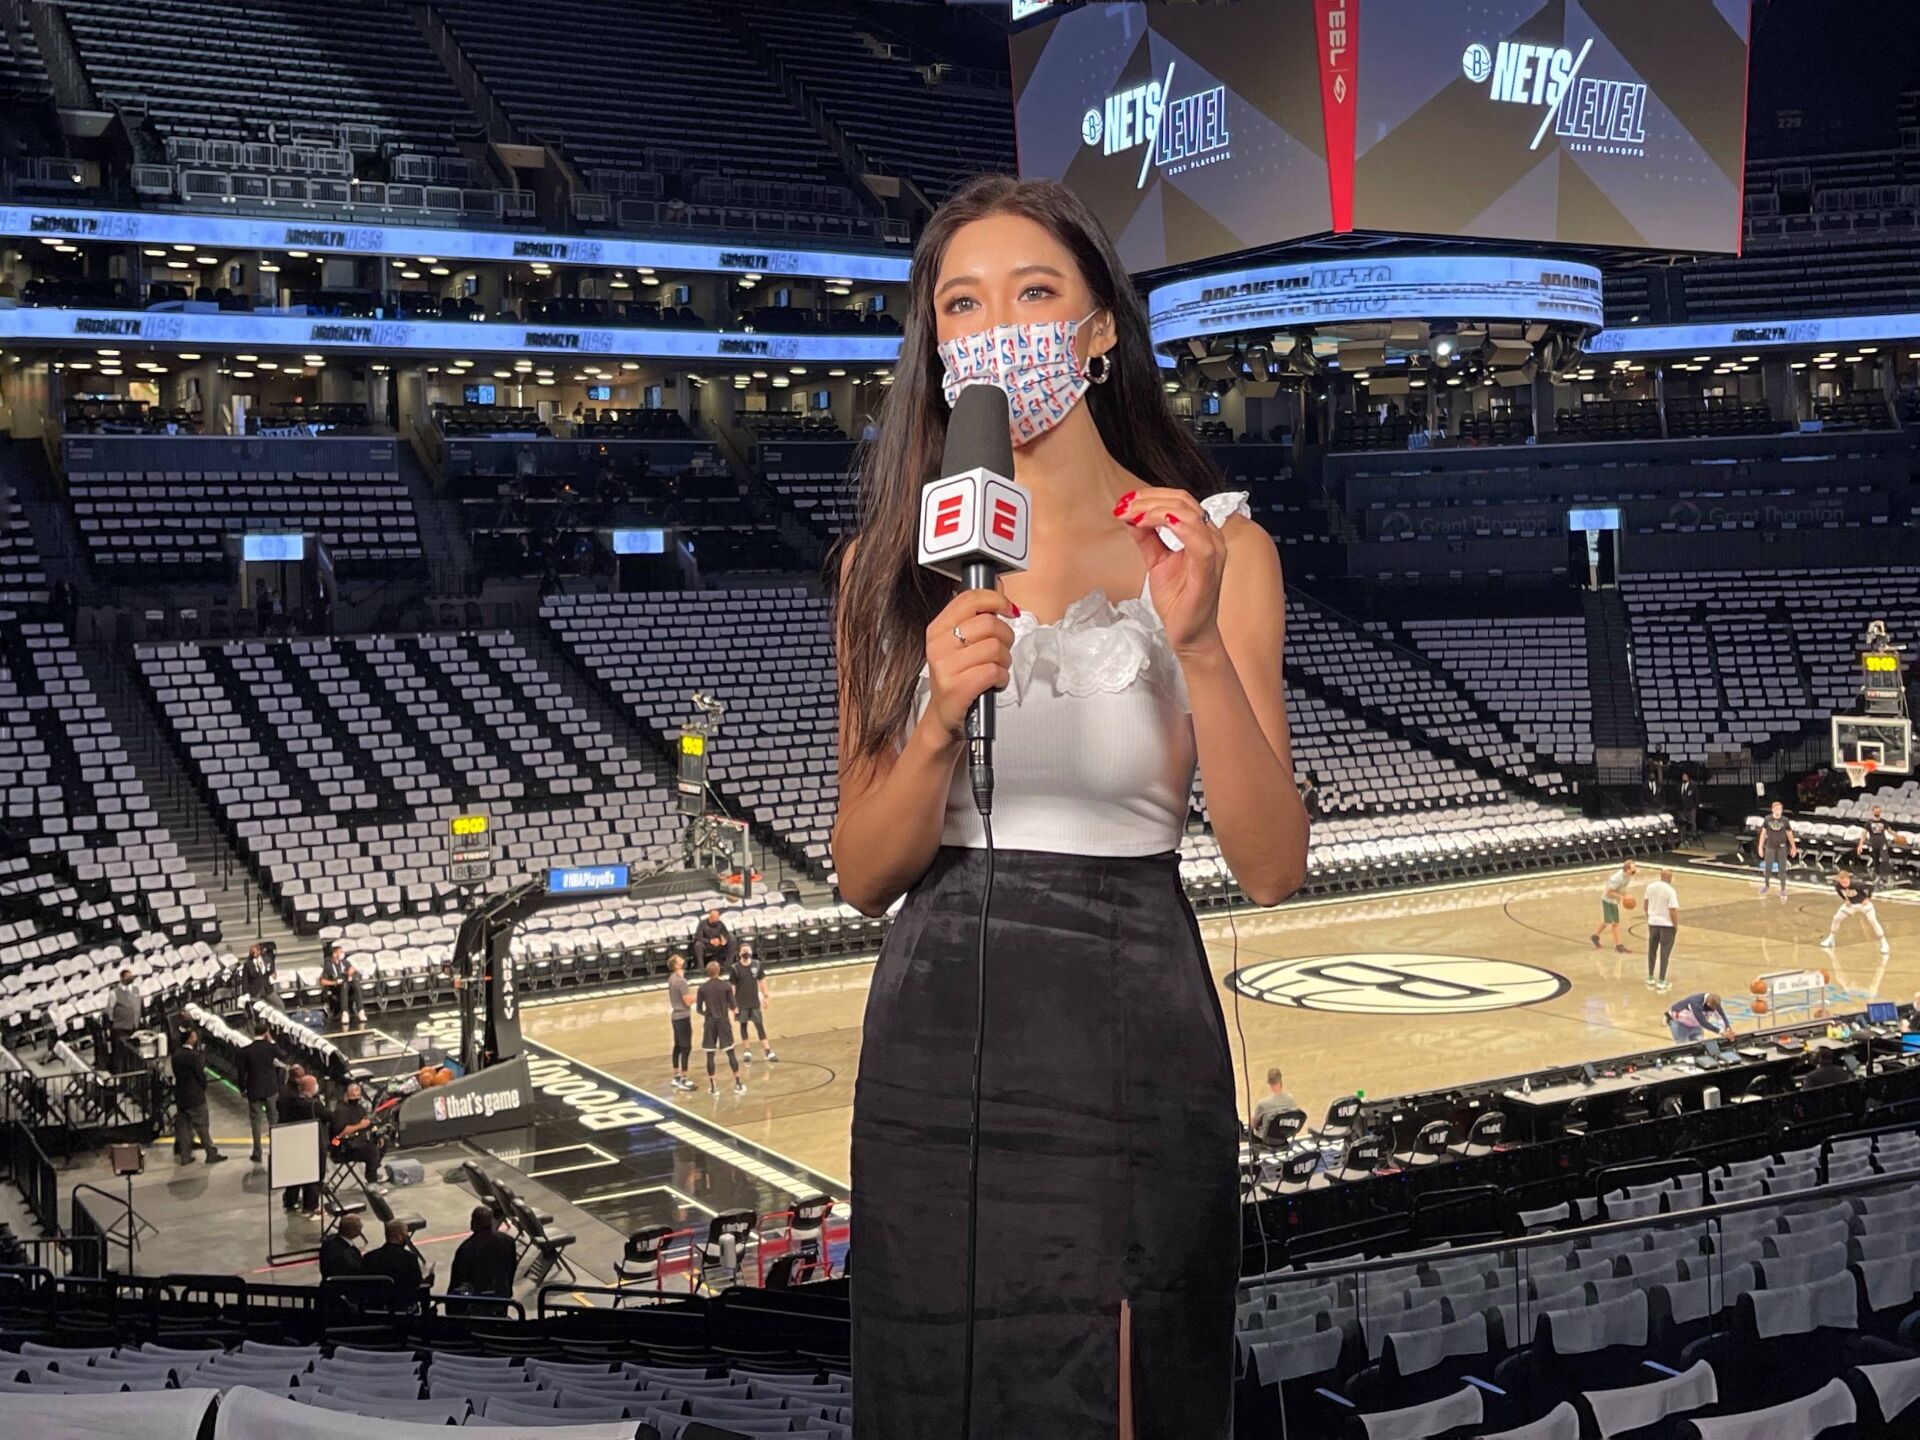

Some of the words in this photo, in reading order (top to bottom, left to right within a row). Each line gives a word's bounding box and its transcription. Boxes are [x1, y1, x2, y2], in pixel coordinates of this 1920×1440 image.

[1490, 41, 1573, 107] NETS
[1555, 77, 1647, 143] LEVEL
[1104, 81, 1161, 156] NETS
[1155, 86, 1229, 166] LEVEL
[1190, 152, 1232, 169] PLAYOFFS
[1597, 145, 1645, 157] PLAYOFFS
[934, 494, 963, 538] E
[992, 498, 1018, 541] E
[1708, 506, 1761, 523] Grant
[1763, 505, 1845, 522] Thornton
[502, 957, 514, 993] NBA
[503, 995, 515, 1020] TV
[446, 1091, 484, 1119] that's
[484, 1089, 520, 1117] game
